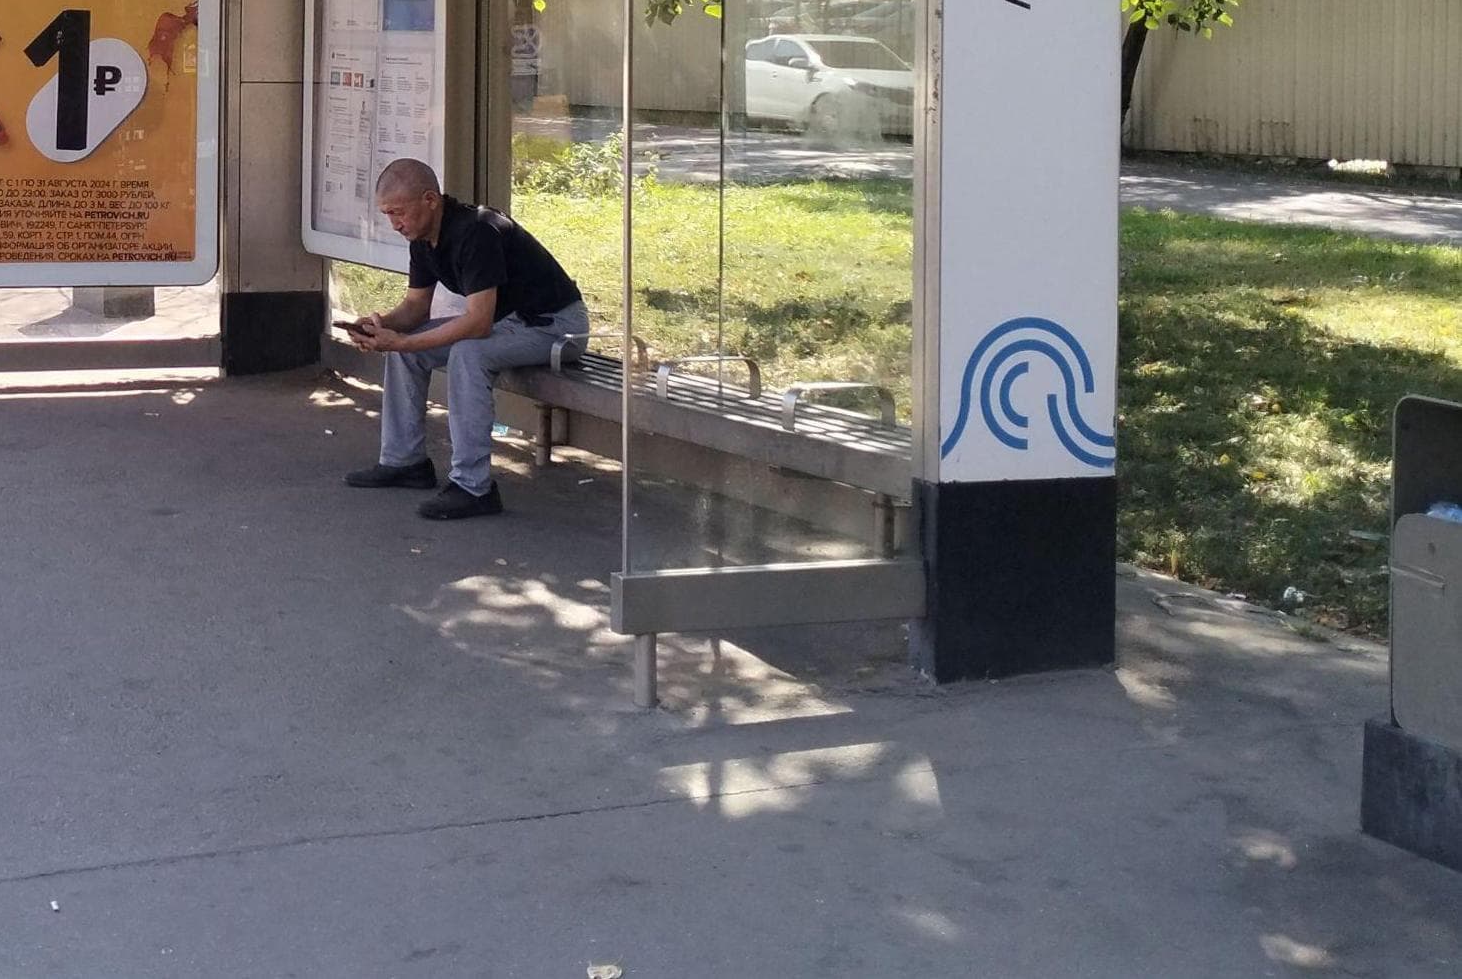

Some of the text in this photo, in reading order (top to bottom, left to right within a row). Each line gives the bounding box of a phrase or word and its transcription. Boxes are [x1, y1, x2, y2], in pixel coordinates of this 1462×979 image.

[23, 9, 91, 150] 1
[6, 179, 13, 187] С
[20, 179, 35, 187] ПО
[36, 179, 46, 187] 31
[48, 179, 88, 188] АВГУСТА
[90, 180, 110, 189] 2024
[120, 180, 149, 189] ВРЕМЯ
[6, 189, 19, 197] ДО
[49, 190, 79, 198] ЗАКАЗ
[81, 190, 93, 198] ОТ
[95, 190, 118, 199] 3000
[38, 200, 71, 209] ДЛИНА
[74, 200, 88, 209] ДО
[90, 200, 96, 209] 3
[109, 201, 126, 209] ВЕС
[128, 201, 142, 210] ДО
[144, 201, 159, 210] 100
[14, 209, 67, 219] УТОЧНЯЙТЕ
[69, 210, 83, 219] НА
[84, 211, 150, 220] PETROVICH.RU
[120, 232, 145, 240] ОГРН
[56, 241, 69, 250] ОБ
[71, 242, 140, 250] ОРГАНИЗАТОРЕ
[58, 252, 95, 261] СРОКАХ
[97, 252, 110, 261] НА
[112, 252, 177, 261] PETROVICH.RU
